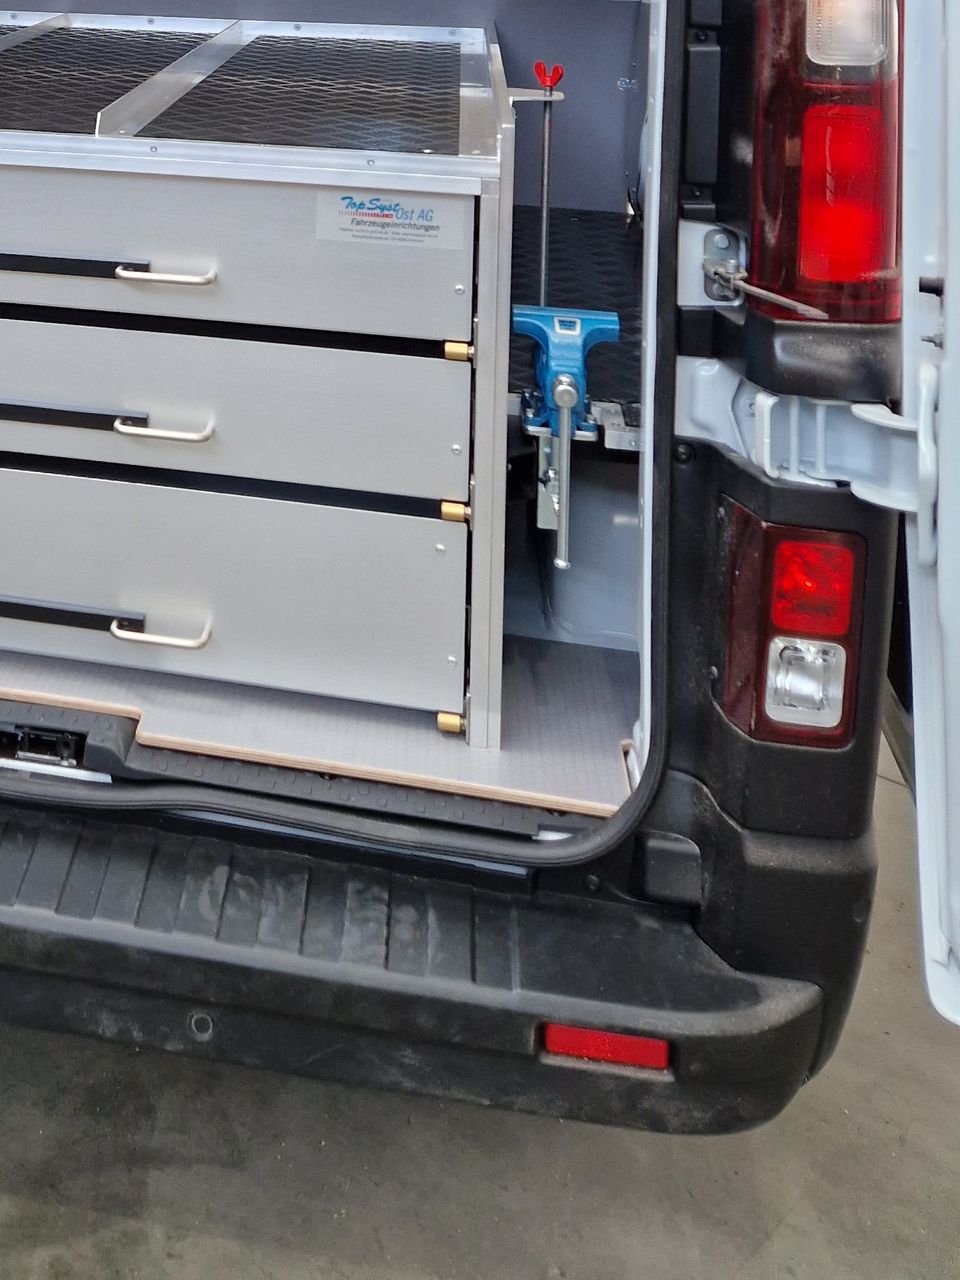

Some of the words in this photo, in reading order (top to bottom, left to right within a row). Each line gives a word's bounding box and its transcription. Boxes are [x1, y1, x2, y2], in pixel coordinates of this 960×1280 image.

[395, 207, 414, 221] Ost
[417, 208, 434, 222] AG
[350, 217, 440, 232] Fahrzeugeinrichtungen
